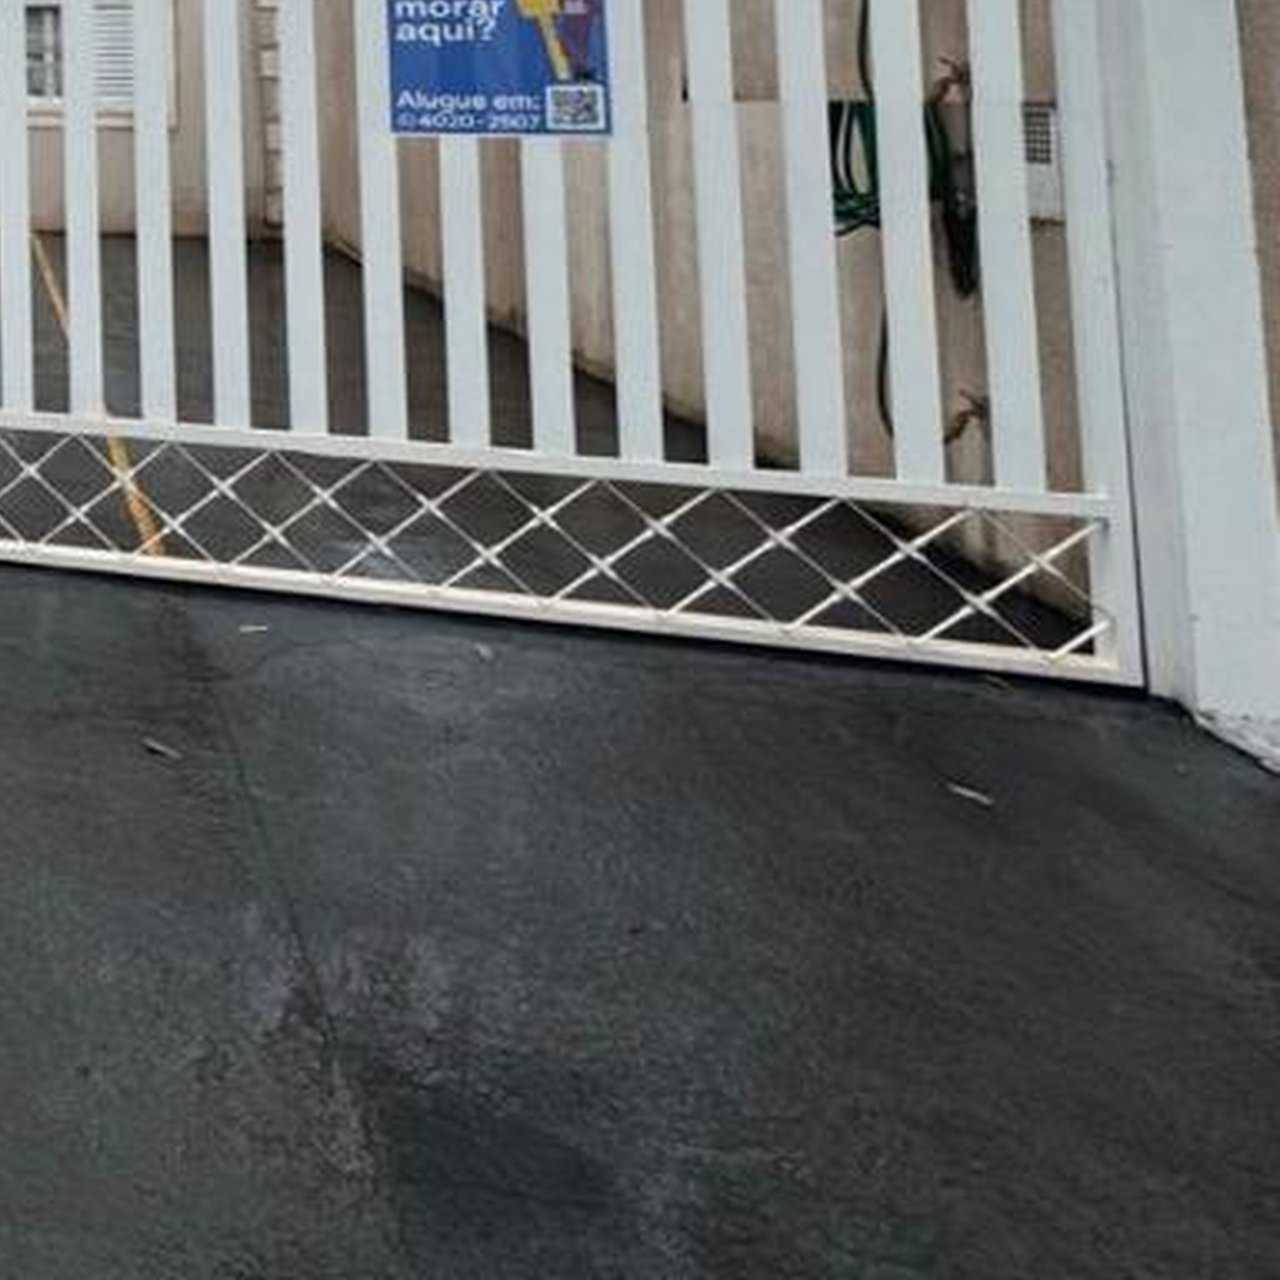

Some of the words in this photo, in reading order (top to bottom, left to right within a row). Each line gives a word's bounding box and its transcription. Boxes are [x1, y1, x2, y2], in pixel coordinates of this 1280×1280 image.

[395, 0, 506, 18] morar
[395, 17, 497, 46] aqui?
[396, 90, 487, 113] Alugue
[492, 94, 542, 111] em:
